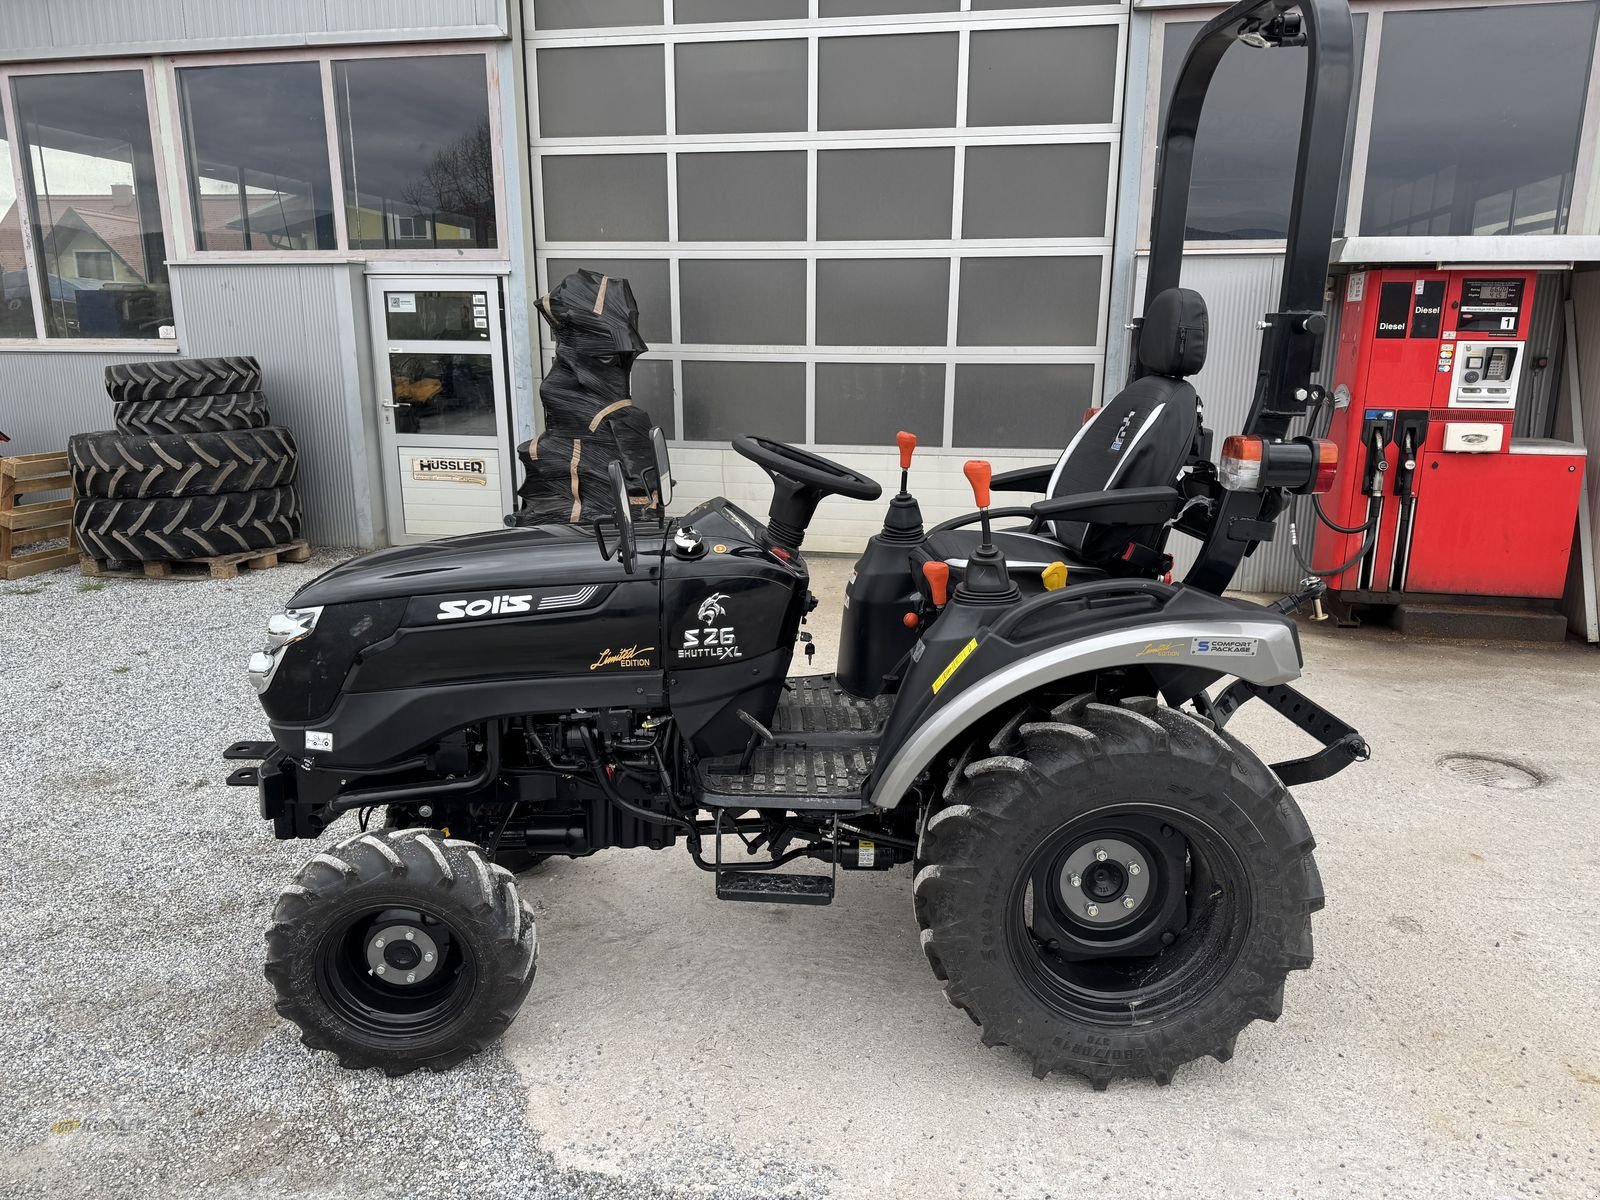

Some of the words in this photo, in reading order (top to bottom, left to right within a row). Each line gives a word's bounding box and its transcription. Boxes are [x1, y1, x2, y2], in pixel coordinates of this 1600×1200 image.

[1416, 306, 1440, 314] Diesel
[1379, 322, 1405, 330] Diesel
[1505, 318, 1511, 328] 1
[420, 460, 482, 473] HÜSSLER
[683, 629, 700, 649] S
[703, 627, 736, 646] 26
[1198, 641, 1210, 652] S
[590, 644, 655, 670] Limited
[620, 659, 650, 667] EDITION
